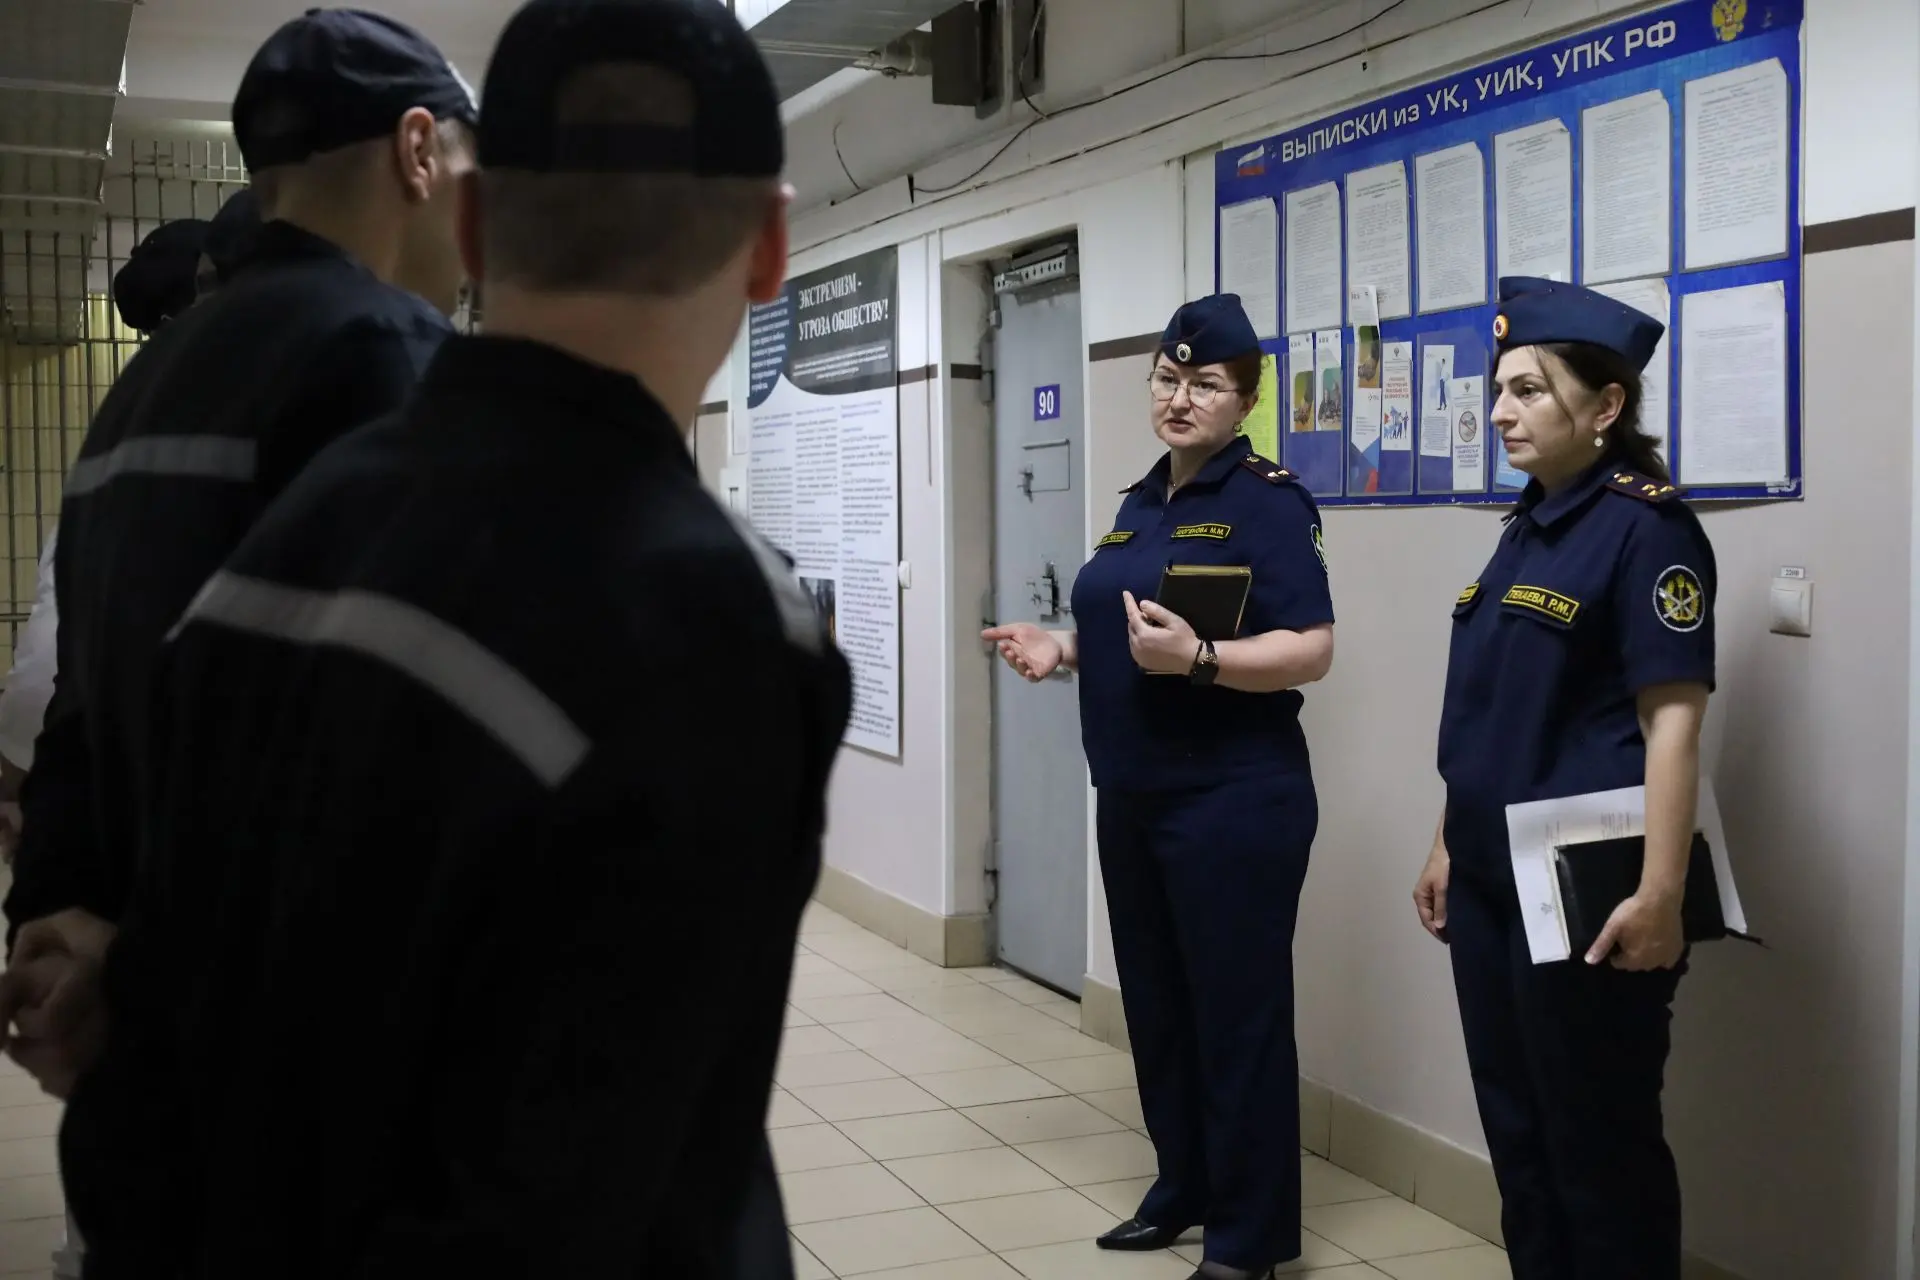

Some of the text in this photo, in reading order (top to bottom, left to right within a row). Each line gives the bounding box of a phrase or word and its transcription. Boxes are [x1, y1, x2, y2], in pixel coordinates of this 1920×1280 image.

[1282, 19, 1677, 163] ВЫПИСКИ из УК, УИК, УПК РФ
[798, 273, 856, 309] ЭКСТРЕМИЗМ
[798, 318, 831, 341] УГРОЗА
[833, 299, 888, 332] ОБЩЕСТВУ!
[1039, 390, 1054, 416] 90
